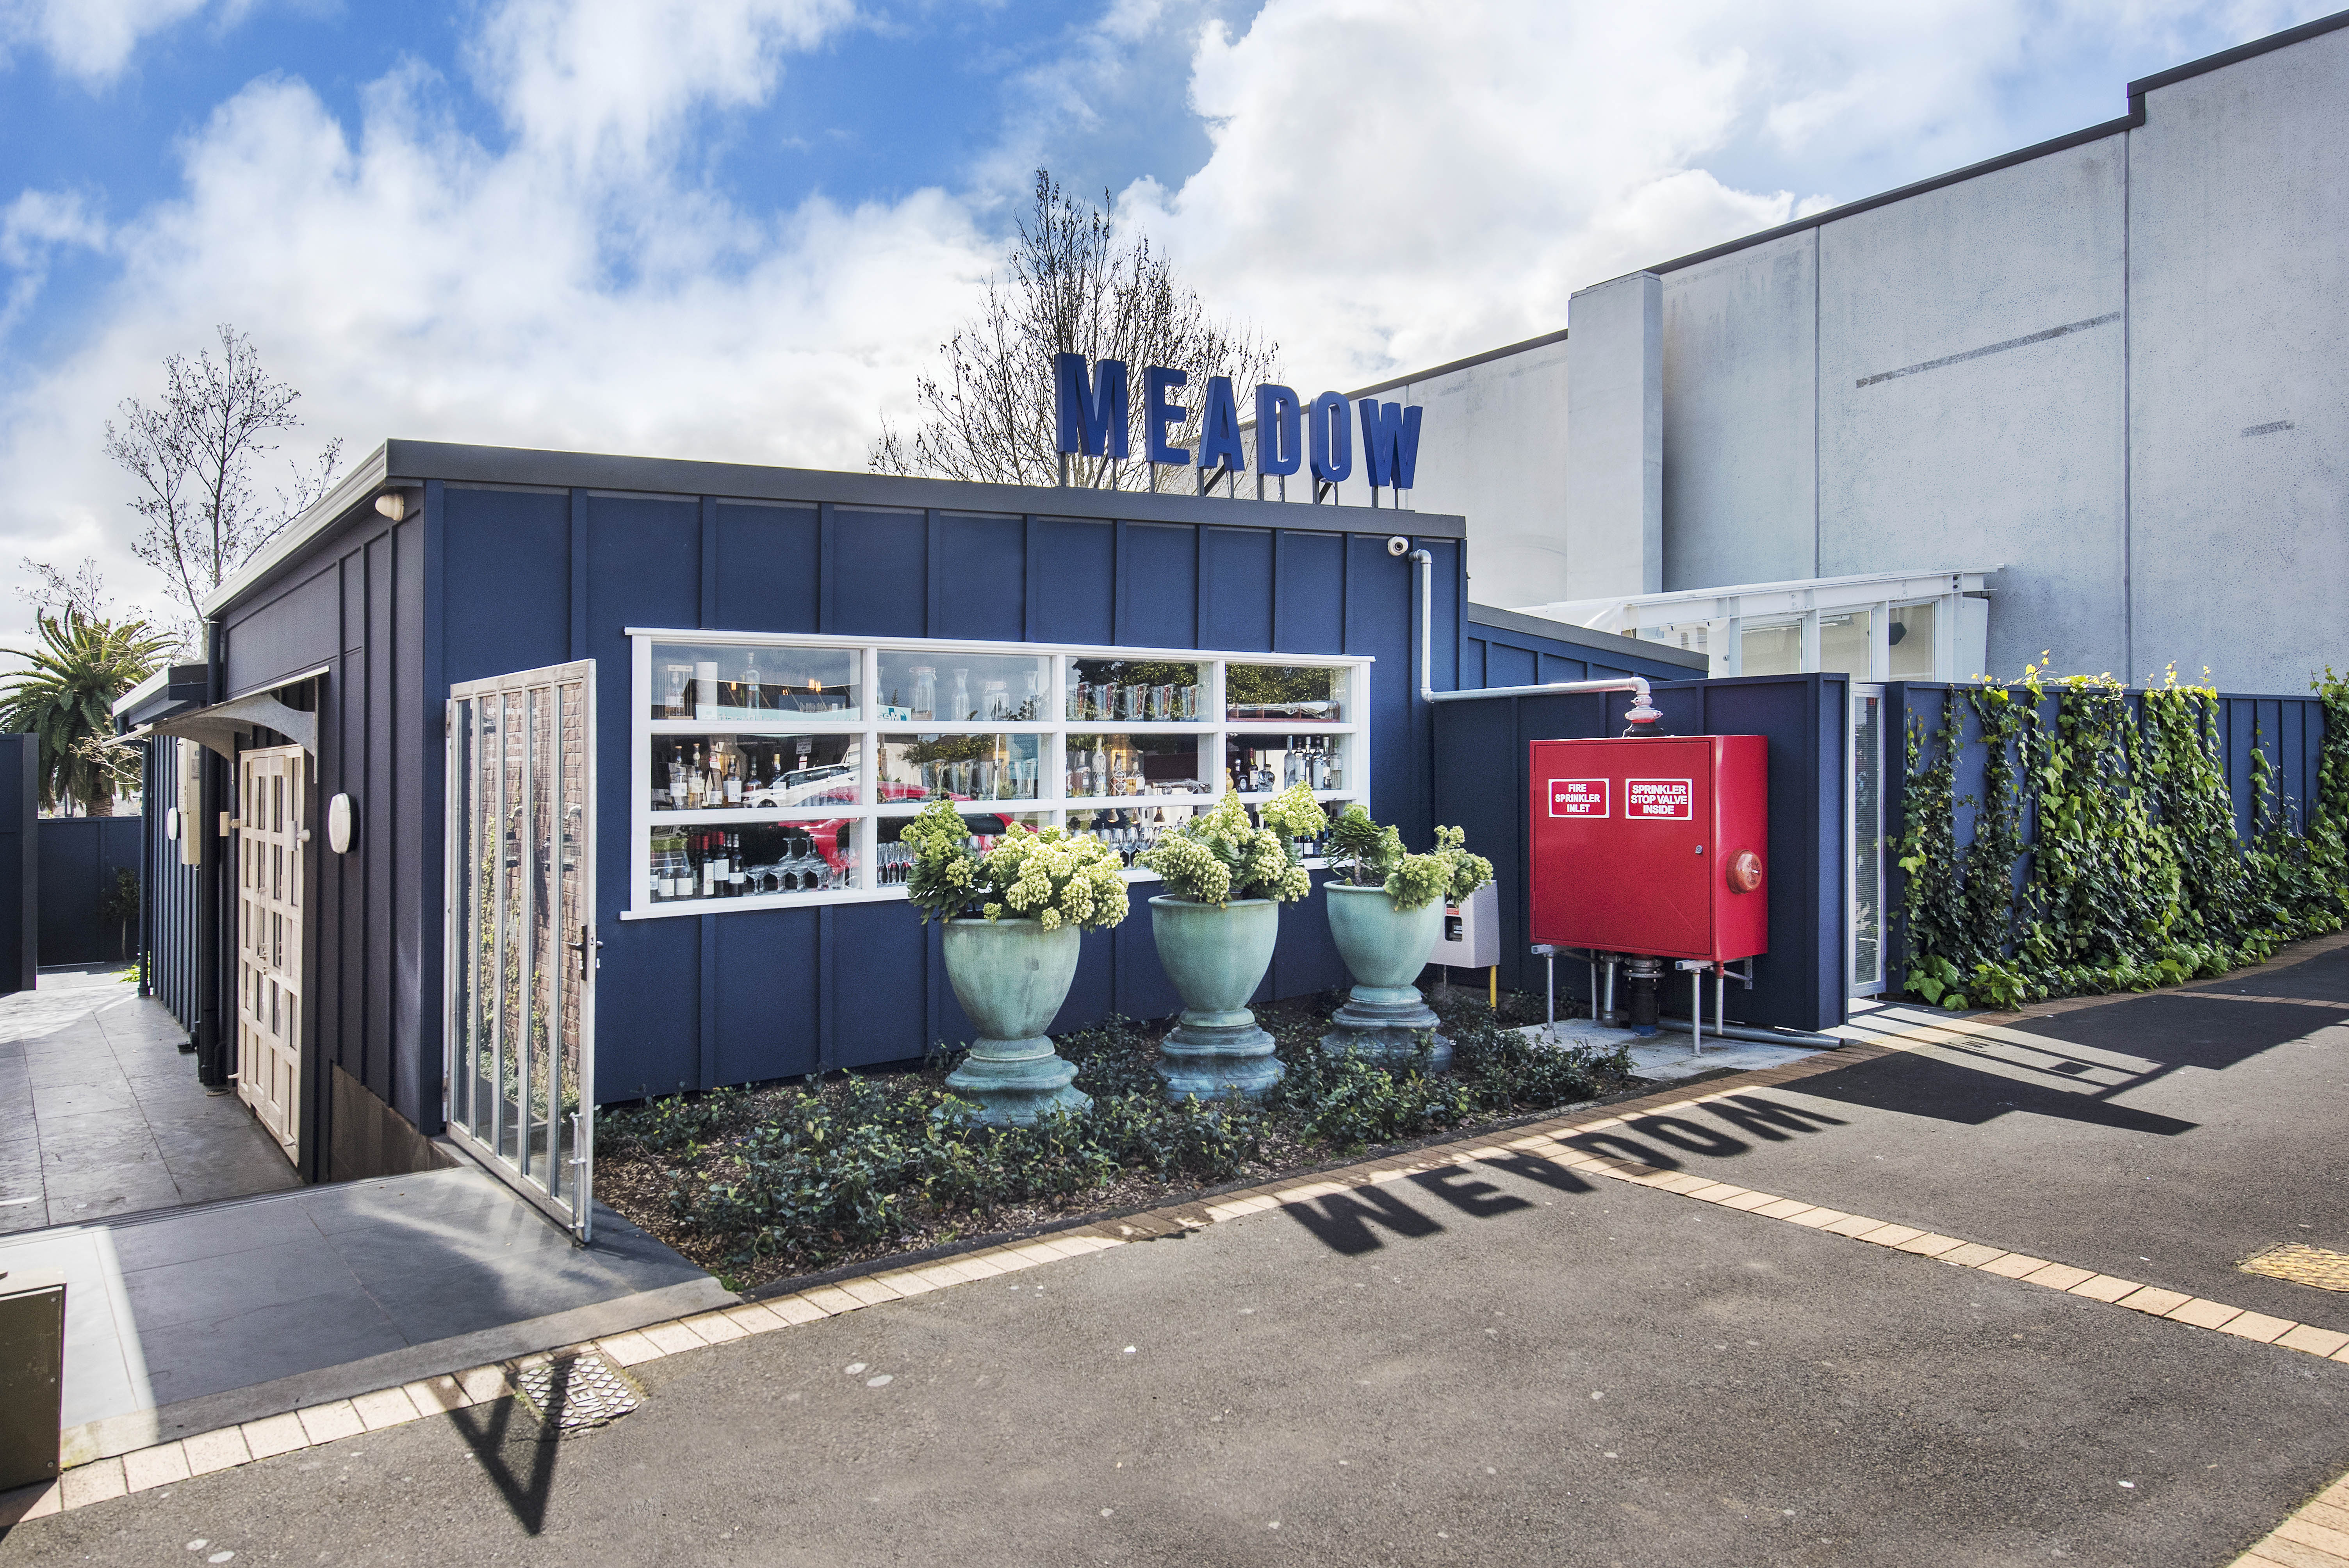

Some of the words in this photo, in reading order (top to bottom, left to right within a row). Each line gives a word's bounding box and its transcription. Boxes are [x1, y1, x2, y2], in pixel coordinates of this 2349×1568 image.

[1054, 352, 1423, 489] MEADOW
[1568, 784, 1586, 792] FIRE
[1632, 785, 1686, 795] SPRINKLER
[1555, 794, 1600, 803] SPRINKLER
[1631, 795, 1656, 804] STOP
[1657, 796, 1688, 804] VALVE
[1567, 804, 1590, 813] INLET
[1643, 805, 1675, 814] INSIDE
